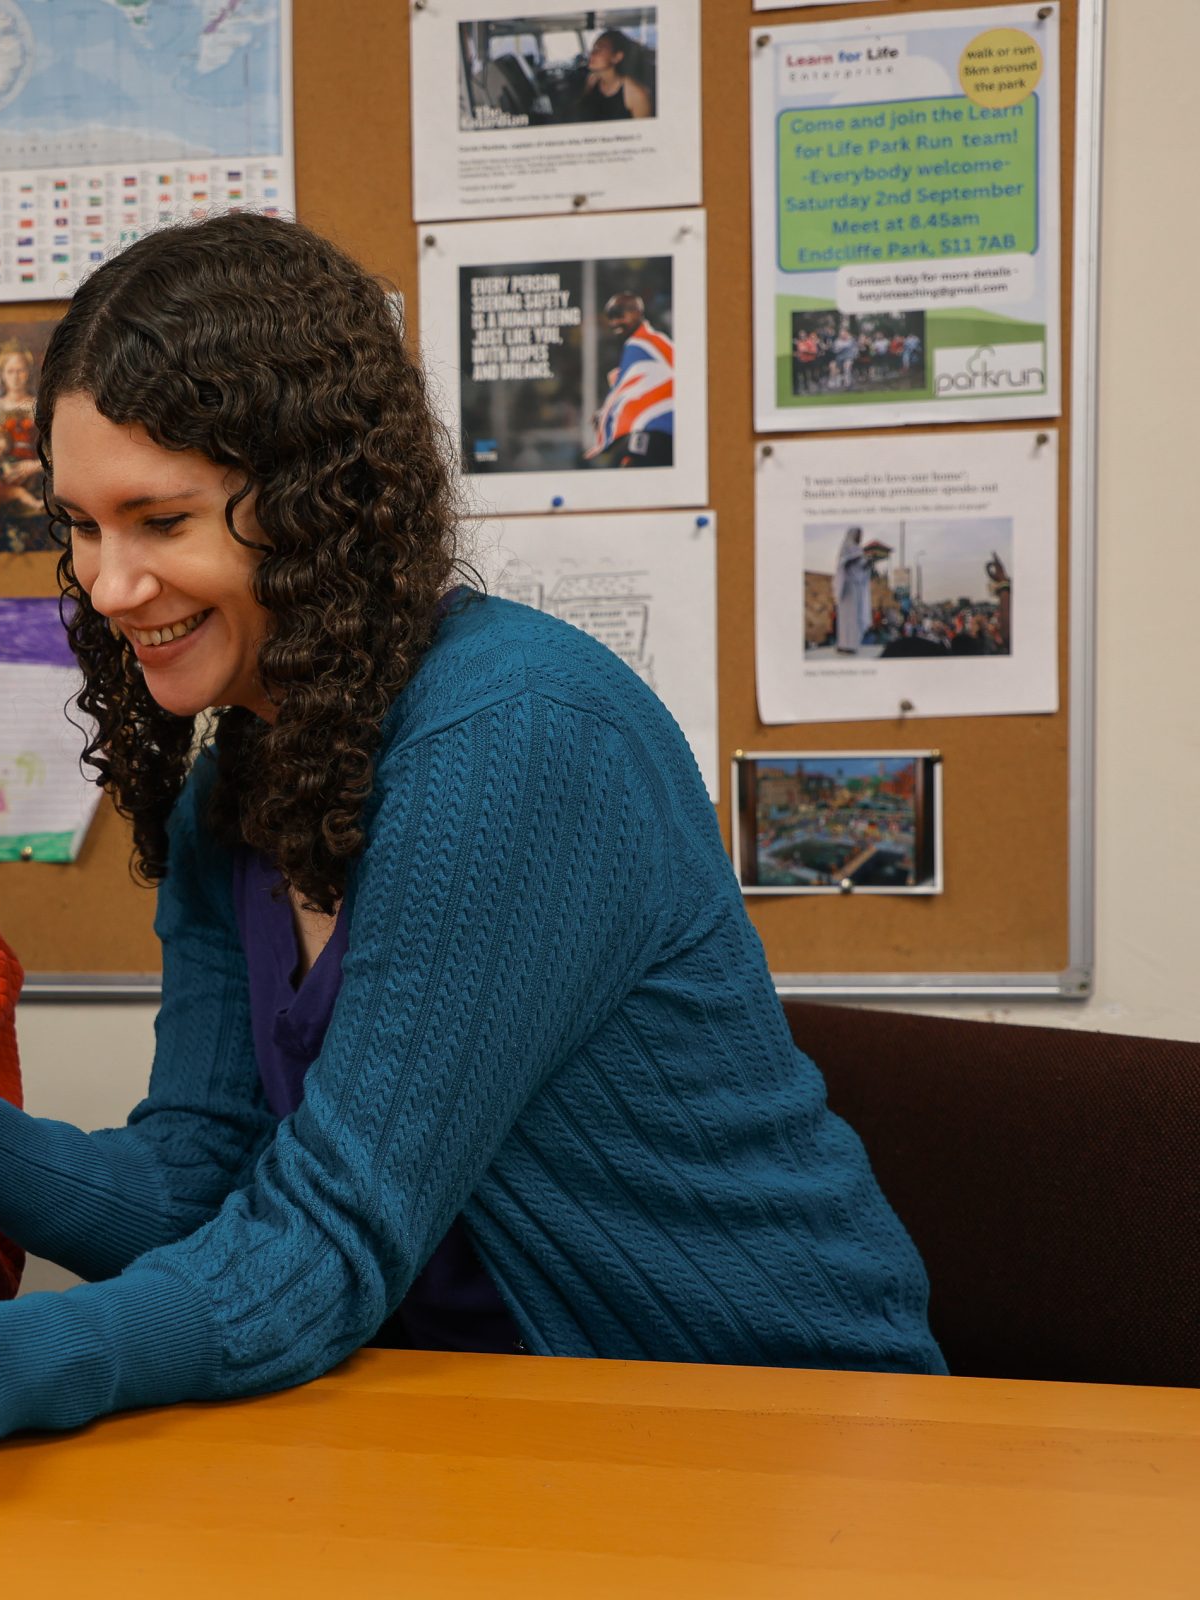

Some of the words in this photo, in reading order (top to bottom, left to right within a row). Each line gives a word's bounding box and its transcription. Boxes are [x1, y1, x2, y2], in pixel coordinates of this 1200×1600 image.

[786, 52, 834, 68] Learn
[838, 49, 862, 64] for
[867, 46, 900, 62] Life
[967, 47, 998, 60] walk
[999, 47, 1010, 58] or
[1013, 44, 1036, 56] run
[789, 65, 895, 82] Enterprise
[992, 60, 1038, 76] around
[974, 80, 996, 92] the
[999, 78, 1027, 93] park
[790, 116, 844, 135] Come
[851, 110, 886, 128] and
[889, 107, 928, 131] join
[932, 104, 963, 122] the
[969, 101, 1024, 121] Learn
[795, 142, 821, 160] for
[827, 139, 863, 158] Life
[868, 134, 910, 155] Park
[916, 133, 953, 150] Run
[962, 127, 1018, 147] team!
[786, 192, 871, 213] Saturday
[875, 187, 911, 207] 2nd
[917, 182, 1025, 206] September
[832, 217, 879, 235] Meet
[886, 215, 903, 232] at
[909, 211, 980, 230] 8.45am
[797, 242, 882, 263] Endcliffe
[940, 236, 971, 254] S11
[977, 233, 1016, 251] 7AB
[471, 276, 510, 295] EVERY
[471, 312, 485, 330] IS
[487, 311, 498, 328] A
[472, 364, 500, 382] AND
[934, 357, 1045, 396] parkrun
